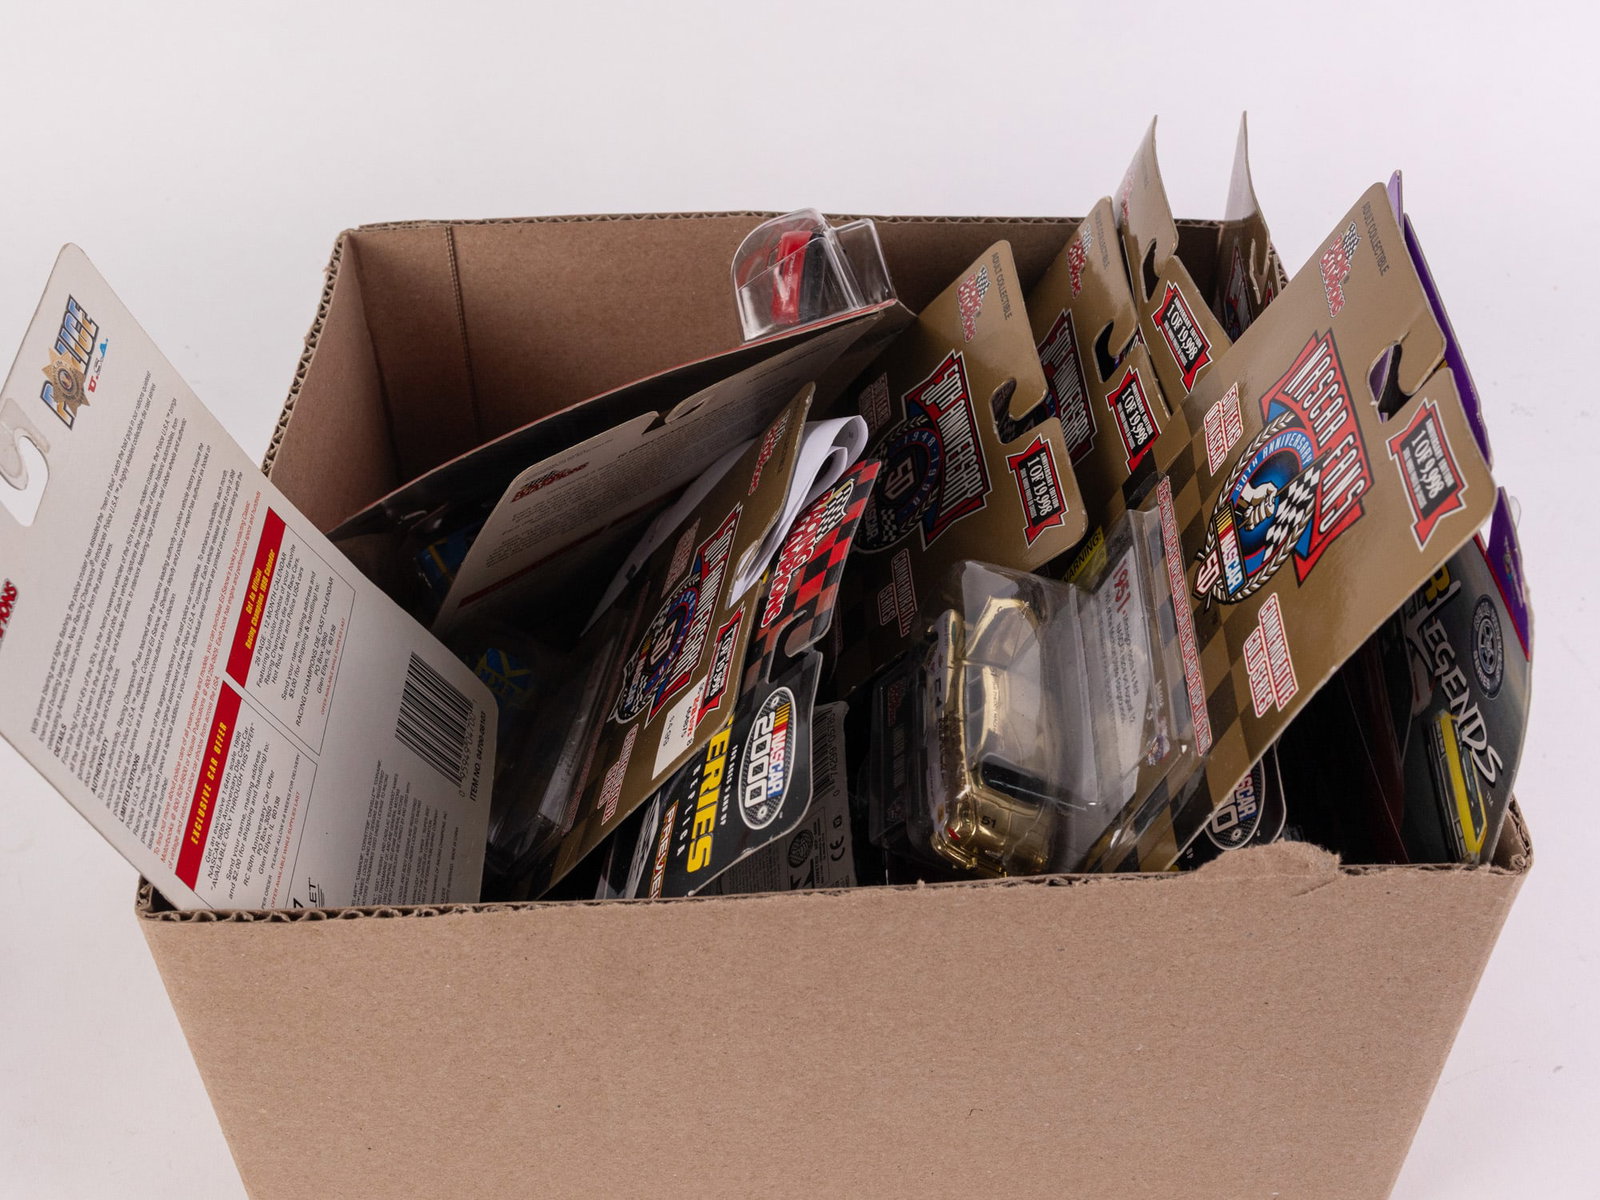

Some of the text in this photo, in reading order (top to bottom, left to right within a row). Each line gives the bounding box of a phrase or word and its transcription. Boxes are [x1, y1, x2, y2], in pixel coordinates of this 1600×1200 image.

[1167, 304, 1175, 317] 1
[1170, 312, 1183, 331] OF
[1178, 325, 1198, 360] 19,998
[1053, 352, 1091, 455] ANNIVERSARY
[1122, 387, 1132, 400] 1
[1124, 396, 1137, 414] OF
[921, 363, 984, 517] 50TH ANNIVERSARY
[1129, 410, 1149, 446] 19,998
[1207, 418, 1226, 473] NASCAR
[1284, 342, 1366, 534] NASCAR FANS
[1412, 430, 1426, 446] 1
[1415, 440, 1433, 464] OF
[885, 457, 914, 499] 50
[1027, 456, 1040, 468] 1
[1030, 466, 1045, 482] OF
[1235, 432, 1315, 492] 50TH ANNIVERSARY
[1420, 458, 1445, 499] 9,998
[1033, 483, 1053, 517] 19,998
[1112, 558, 1131, 614] 1951
[1196, 550, 1221, 594] 50
[1219, 530, 1244, 595] NASCAR
[256, 634, 266, 656] PAGE
[265, 590, 276, 620] MONTH
[273, 551, 286, 590] CALENDAR
[256, 652, 269, 687] Featuring
[274, 594, 283, 620] photos
[280, 584, 285, 594] of
[285, 543, 295, 569] favorite
[263, 659, 274, 685] Racing
[270, 618, 284, 658] Champions
[286, 573, 295, 591] Race
[664, 560, 725, 692] ANNIVERSARY
[880, 585, 896, 624] SERIES
[270, 669, 278, 684] Hot
[278, 633, 287, 651] Mint
[286, 598, 296, 619] Police
[292, 581, 300, 597] USA
[295, 695, 306, 726] RACING
[303, 648, 317, 695] CHAMPIONS
[316, 613, 325, 635] CAST
[321, 576, 333, 614] CALENDAR
[1260, 595, 1297, 706] COMMEMORATIVE
[1246, 631, 1274, 714] GOLD SERIES
[1405, 580, 1503, 787] LEGENDS
[53, 723, 66, 757] DETAILS
[90, 736, 108, 793] AUTHENTICITY
[744, 711, 775, 808] 2000
[767, 729, 787, 796] NASCAR
[118, 753, 140, 822] LIMITED EDITIONS
[190, 721, 226, 844] EXCLUSIVE CAR OFFER
[204, 847, 213, 863] Get
[210, 835, 215, 847] an
[213, 796, 225, 834] exclusive
[221, 771, 231, 794] 1:64th
[228, 750, 236, 771] scale
[223, 815, 232, 839] ONLY
[229, 772, 243, 813] THROUGH
[239, 752, 248, 771] THIS
[266, 769, 274, 789] Offer
[470, 778, 479, 801] ITEM
[686, 714, 734, 873] ERIES
[1236, 773, 1259, 821] SCAR
[207, 840, 220, 878] NASCAR
[217, 821, 225, 840] 50th
[222, 773, 237, 820] Anniversary
[237, 740, 245, 758] Cast
[225, 857, 235, 880] Send
[232, 838, 240, 857] your
[243, 781, 254, 810] mailing
[251, 750, 261, 780] address
[251, 804, 267, 853] Anniversary
[259, 826, 267, 842] Box
[981, 815, 997, 829] 51
[231, 858, 241, 881] $2.00
[242, 806, 254, 841] shipping
[246, 854, 255, 872] 50th
[256, 842, 263, 856] PO
[258, 855, 266, 874] Glen
[243, 872, 250, 886] RC
